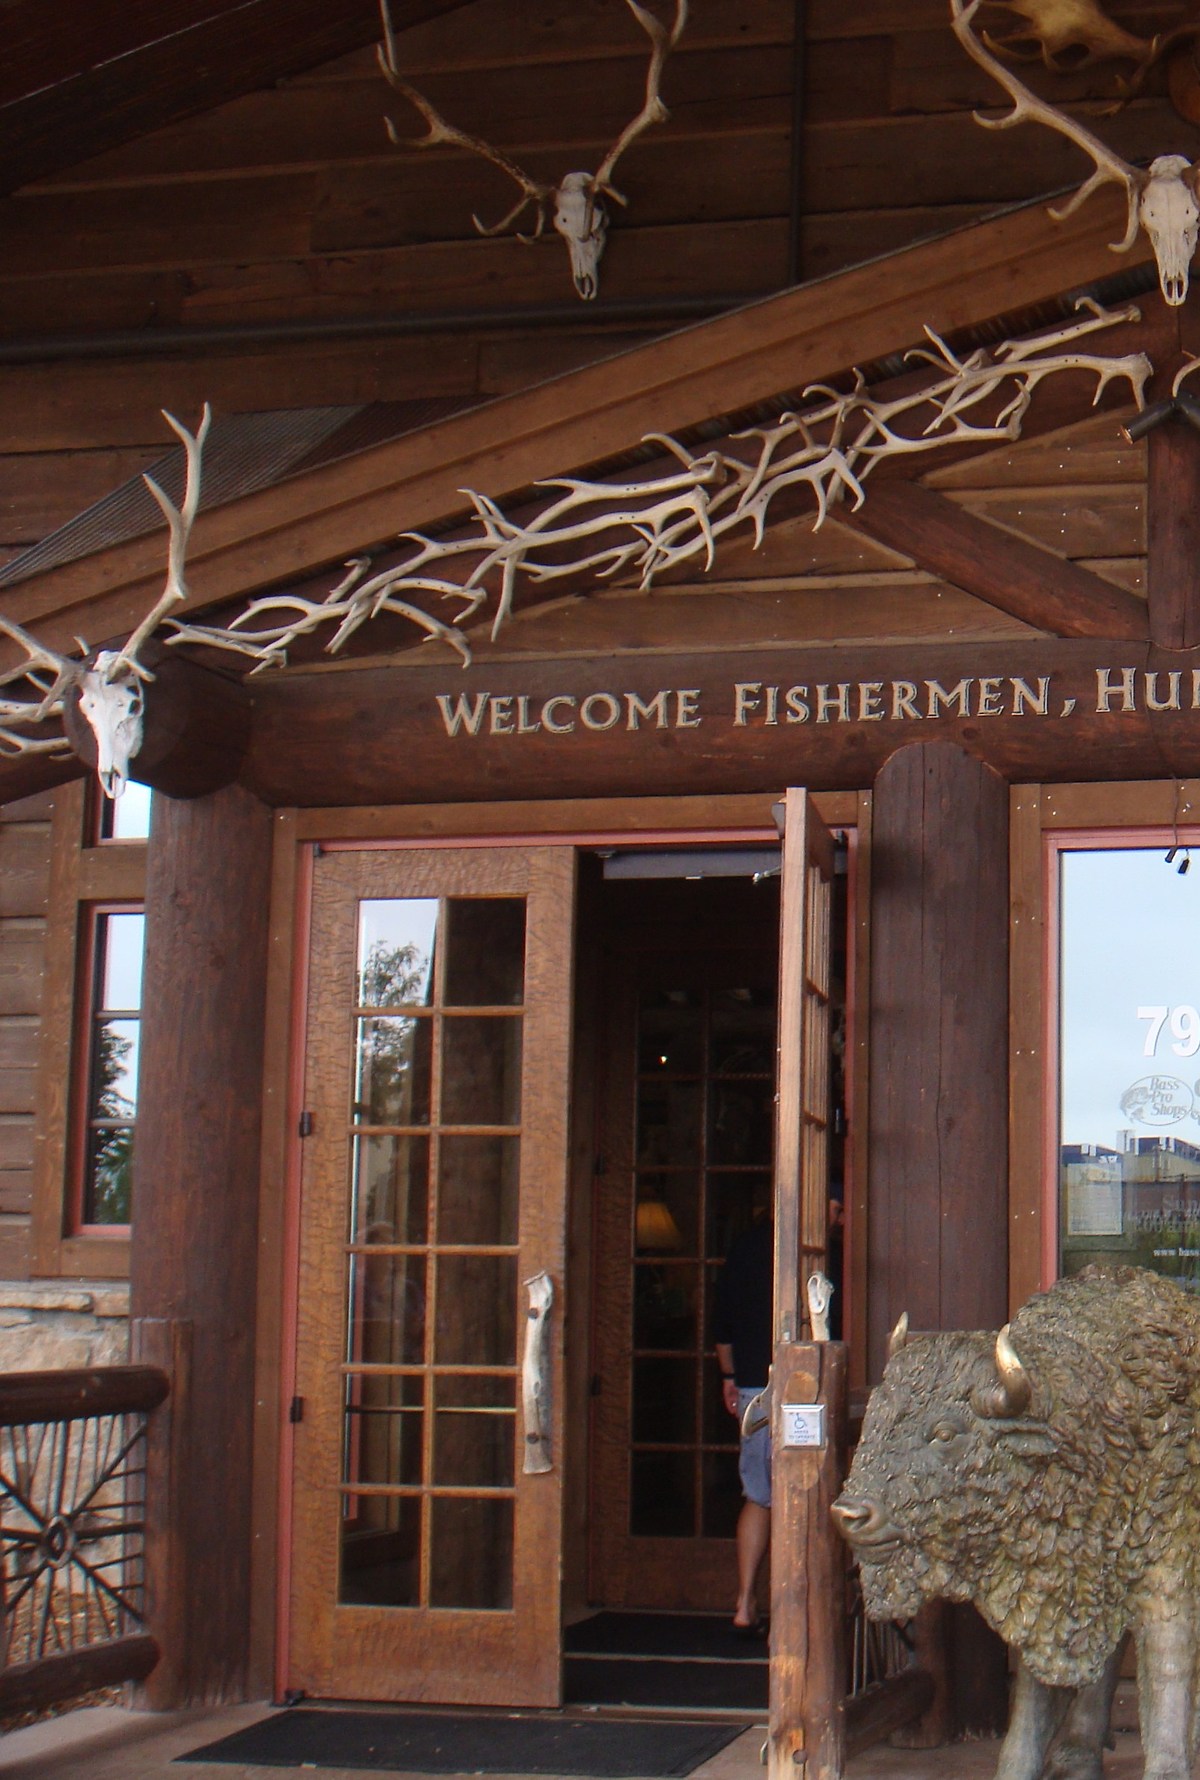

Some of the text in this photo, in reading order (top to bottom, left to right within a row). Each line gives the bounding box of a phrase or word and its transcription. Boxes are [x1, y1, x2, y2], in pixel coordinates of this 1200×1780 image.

[436, 688, 702, 738] WELCOME
[732, 675, 1076, 727] FISHERMEN,
[1150, 1077, 1180, 1091] Bass
[1152, 1091, 1173, 1103] Pro
[1151, 1102, 1188, 1119] Shops
